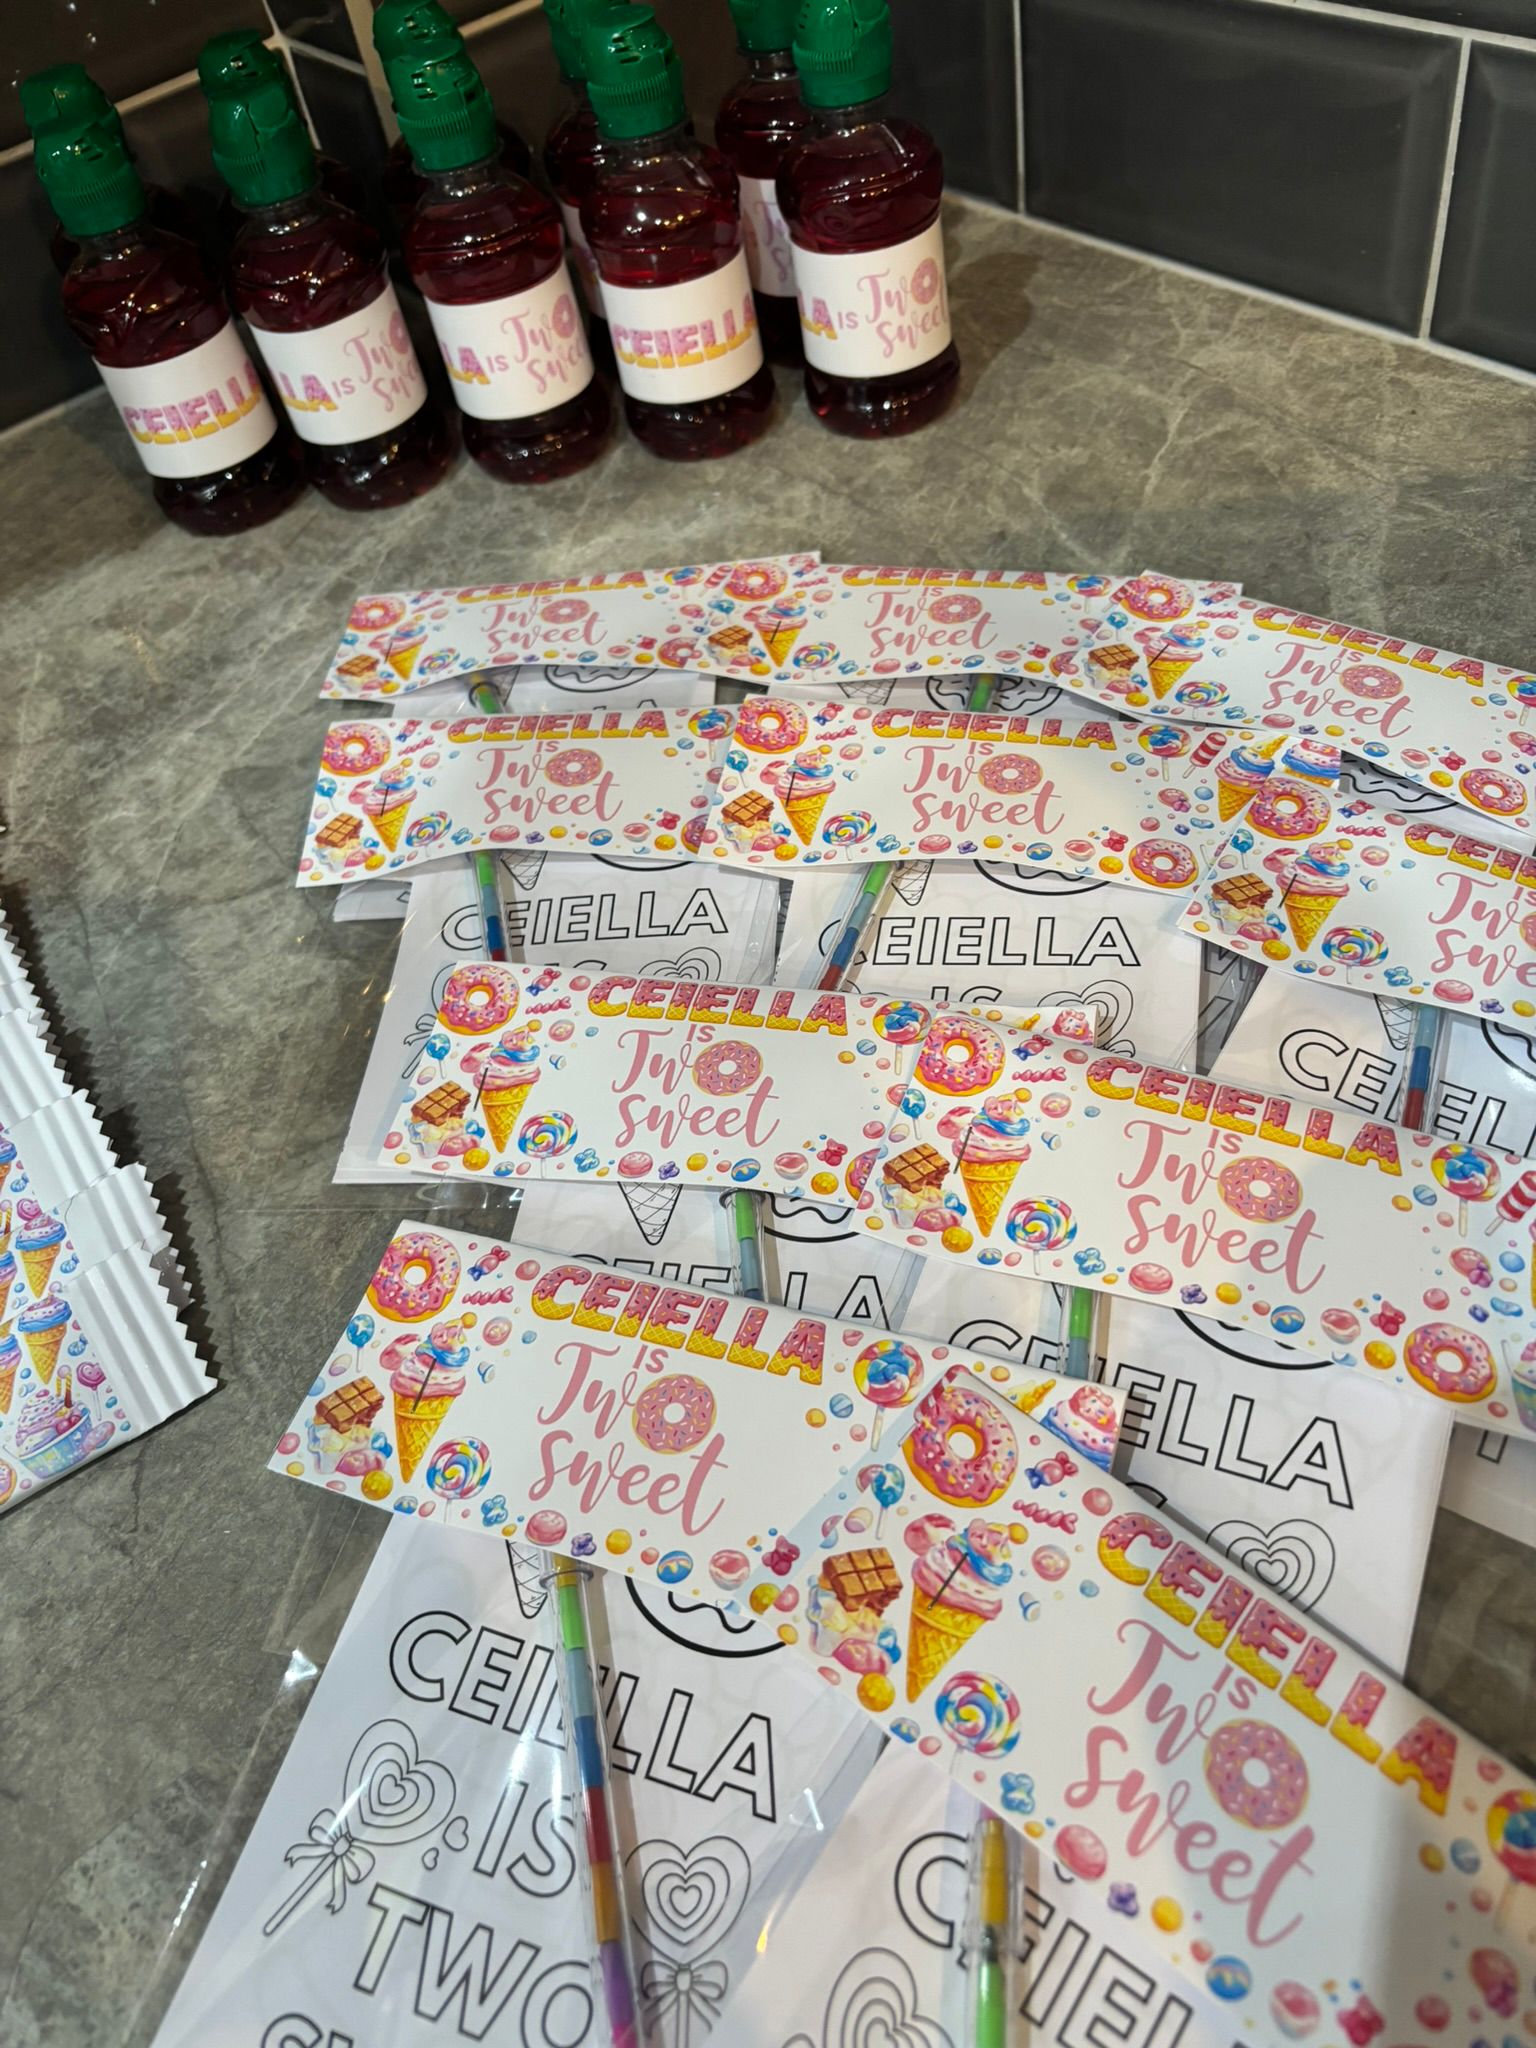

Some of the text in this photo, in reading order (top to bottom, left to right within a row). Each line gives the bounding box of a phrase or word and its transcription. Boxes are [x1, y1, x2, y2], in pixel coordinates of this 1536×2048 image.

[837, 311, 860, 330] IS
[486, 355, 510, 374] IS
[331, 377, 356, 398] IS
[455, 570, 648, 603] CEIELLA
[842, 565, 1048, 591] CEIELLA
[922, 587, 944, 598] IS
[1253, 606, 1484, 687] CEIELLA
[1338, 647, 1365, 663] IS
[447, 710, 670, 743] CEIELLA
[872, 708, 1118, 750] CEIELLA
[537, 741, 557, 753] IS
[969, 742, 995, 756] IS
[587, 975, 849, 1036] CEIELLA
[686, 1023, 717, 1044] IS
[1086, 1056, 1403, 1177] CEIELLA
[1207, 1128, 1245, 1155] IS
[531, 1264, 827, 1387] CEIELLA
[633, 1344, 670, 1374] IS
[1097, 1511, 1459, 1818] CEIELLA
[1211, 1664, 1259, 1711] IS
[473, 1780, 577, 1899] IS
[353, 1882, 601, 2048] TWO
